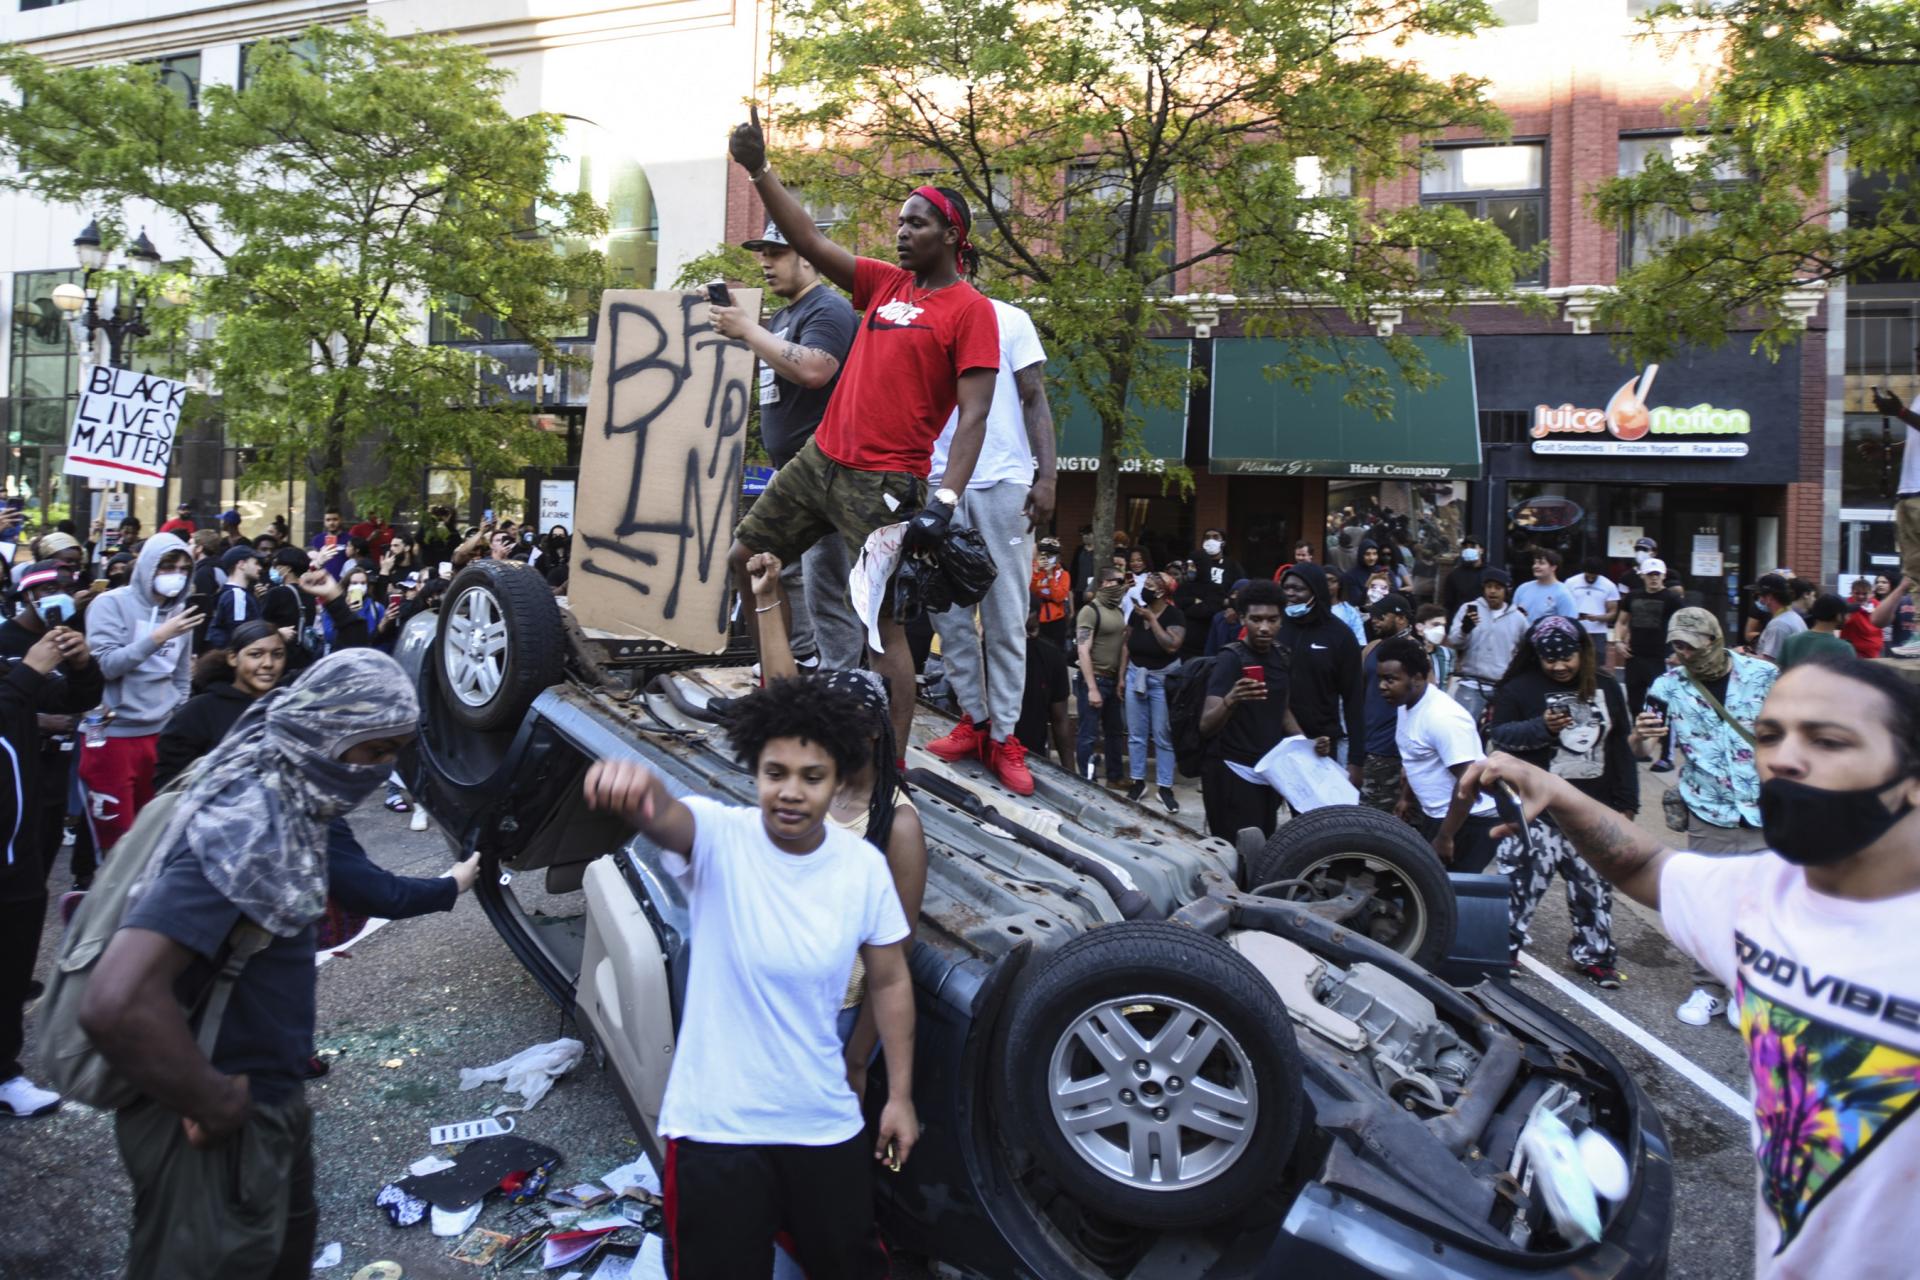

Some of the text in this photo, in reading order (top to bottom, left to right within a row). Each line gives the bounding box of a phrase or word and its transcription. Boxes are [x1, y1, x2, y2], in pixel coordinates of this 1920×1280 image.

[88, 365, 187, 411] BLACK
[79, 394, 176, 441] LIVES
[1651, 403, 1749, 434] nation
[73, 423, 170, 468] MATTER
[604, 302, 742, 634] BLM
[1349, 463, 1379, 474] Hair
[1382, 464, 1451, 477] Company
[542, 497, 559, 507] For
[542, 510, 569, 519] Lease
